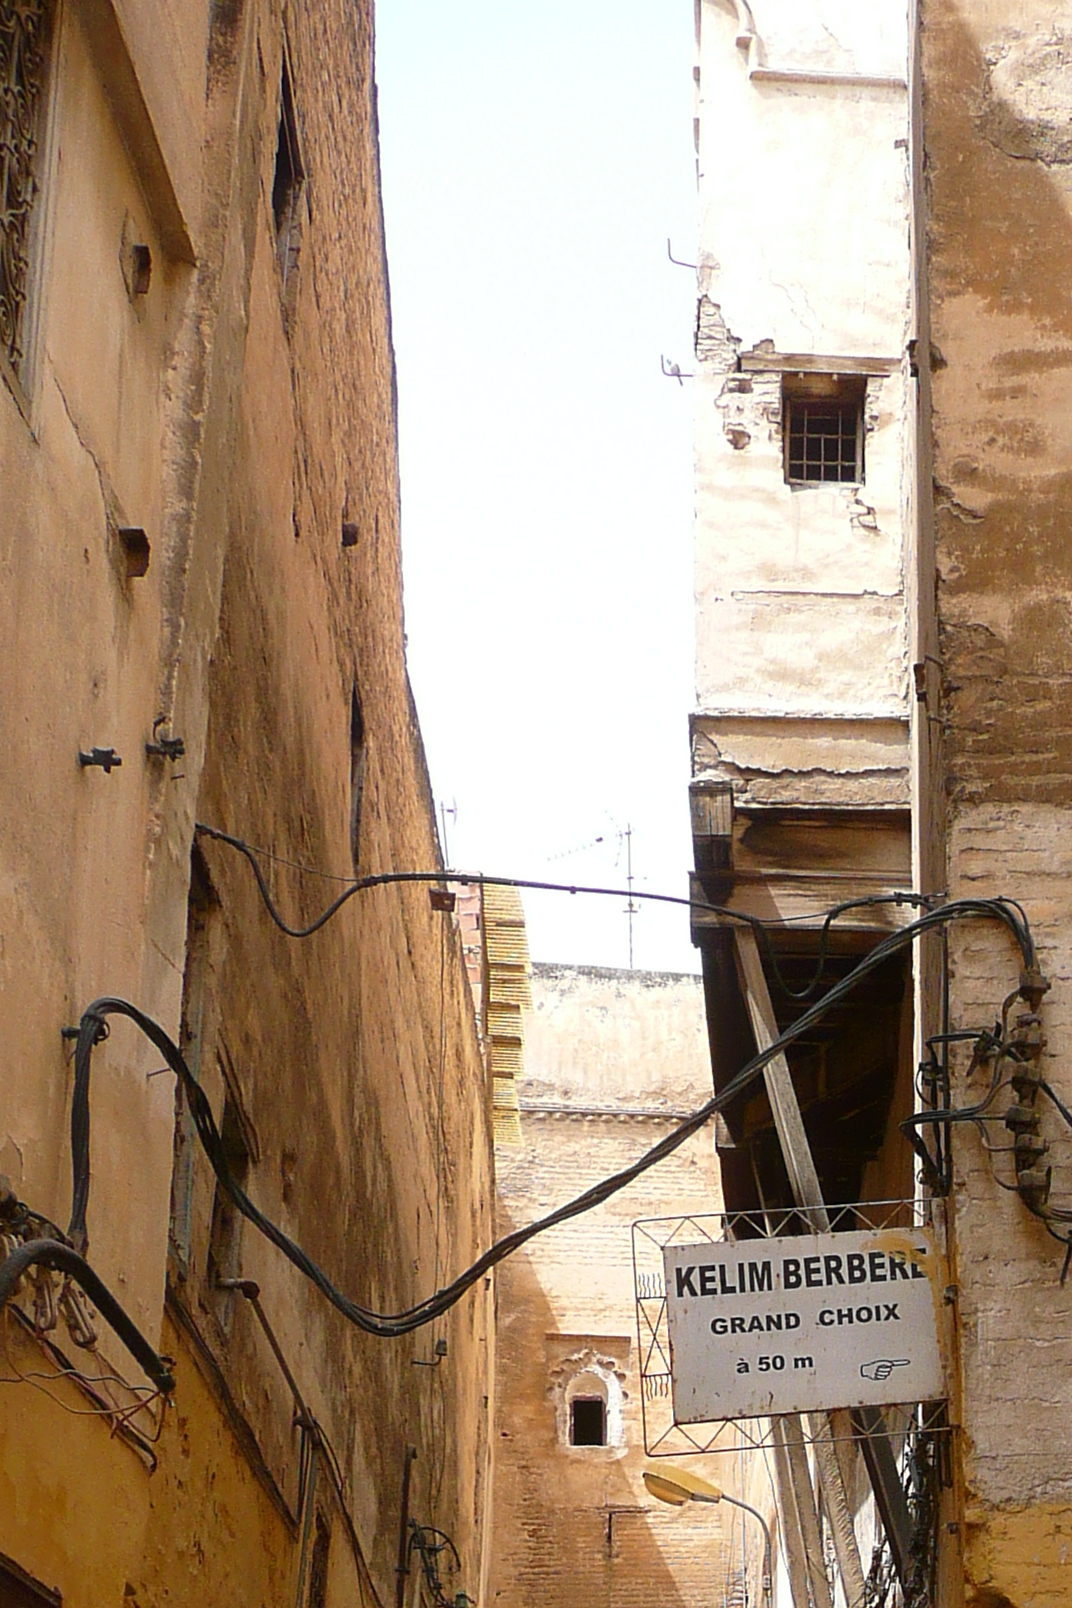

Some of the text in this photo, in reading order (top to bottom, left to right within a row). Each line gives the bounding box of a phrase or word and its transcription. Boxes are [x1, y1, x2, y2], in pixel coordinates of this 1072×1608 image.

[675, 1259, 773, 1298] KELIM
[710, 1303, 901, 1335] GRAND CHOIX
[736, 1355, 814, 1374] à 50 m
